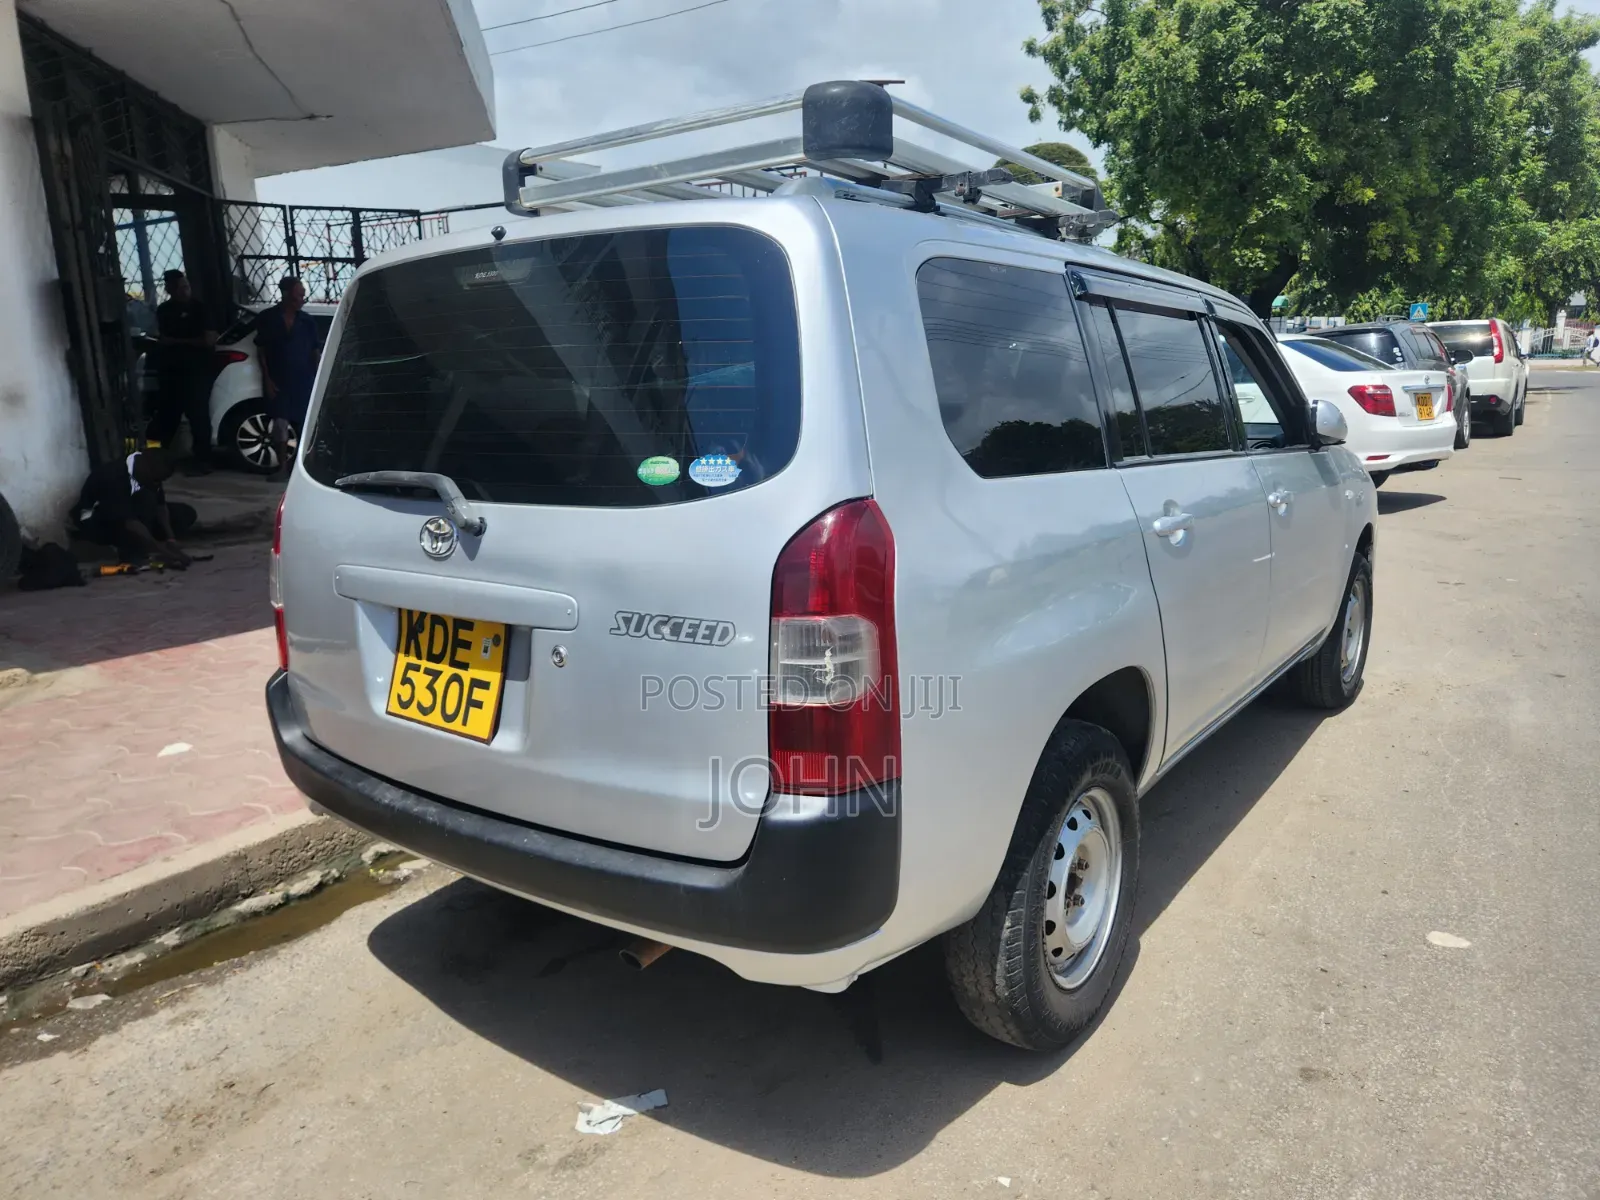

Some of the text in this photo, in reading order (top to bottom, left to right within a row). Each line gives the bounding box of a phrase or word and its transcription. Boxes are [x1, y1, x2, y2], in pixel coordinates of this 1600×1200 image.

[404, 609, 475, 671] KDE
[609, 610, 737, 647] SUCCEED
[397, 662, 491, 727] 530F
